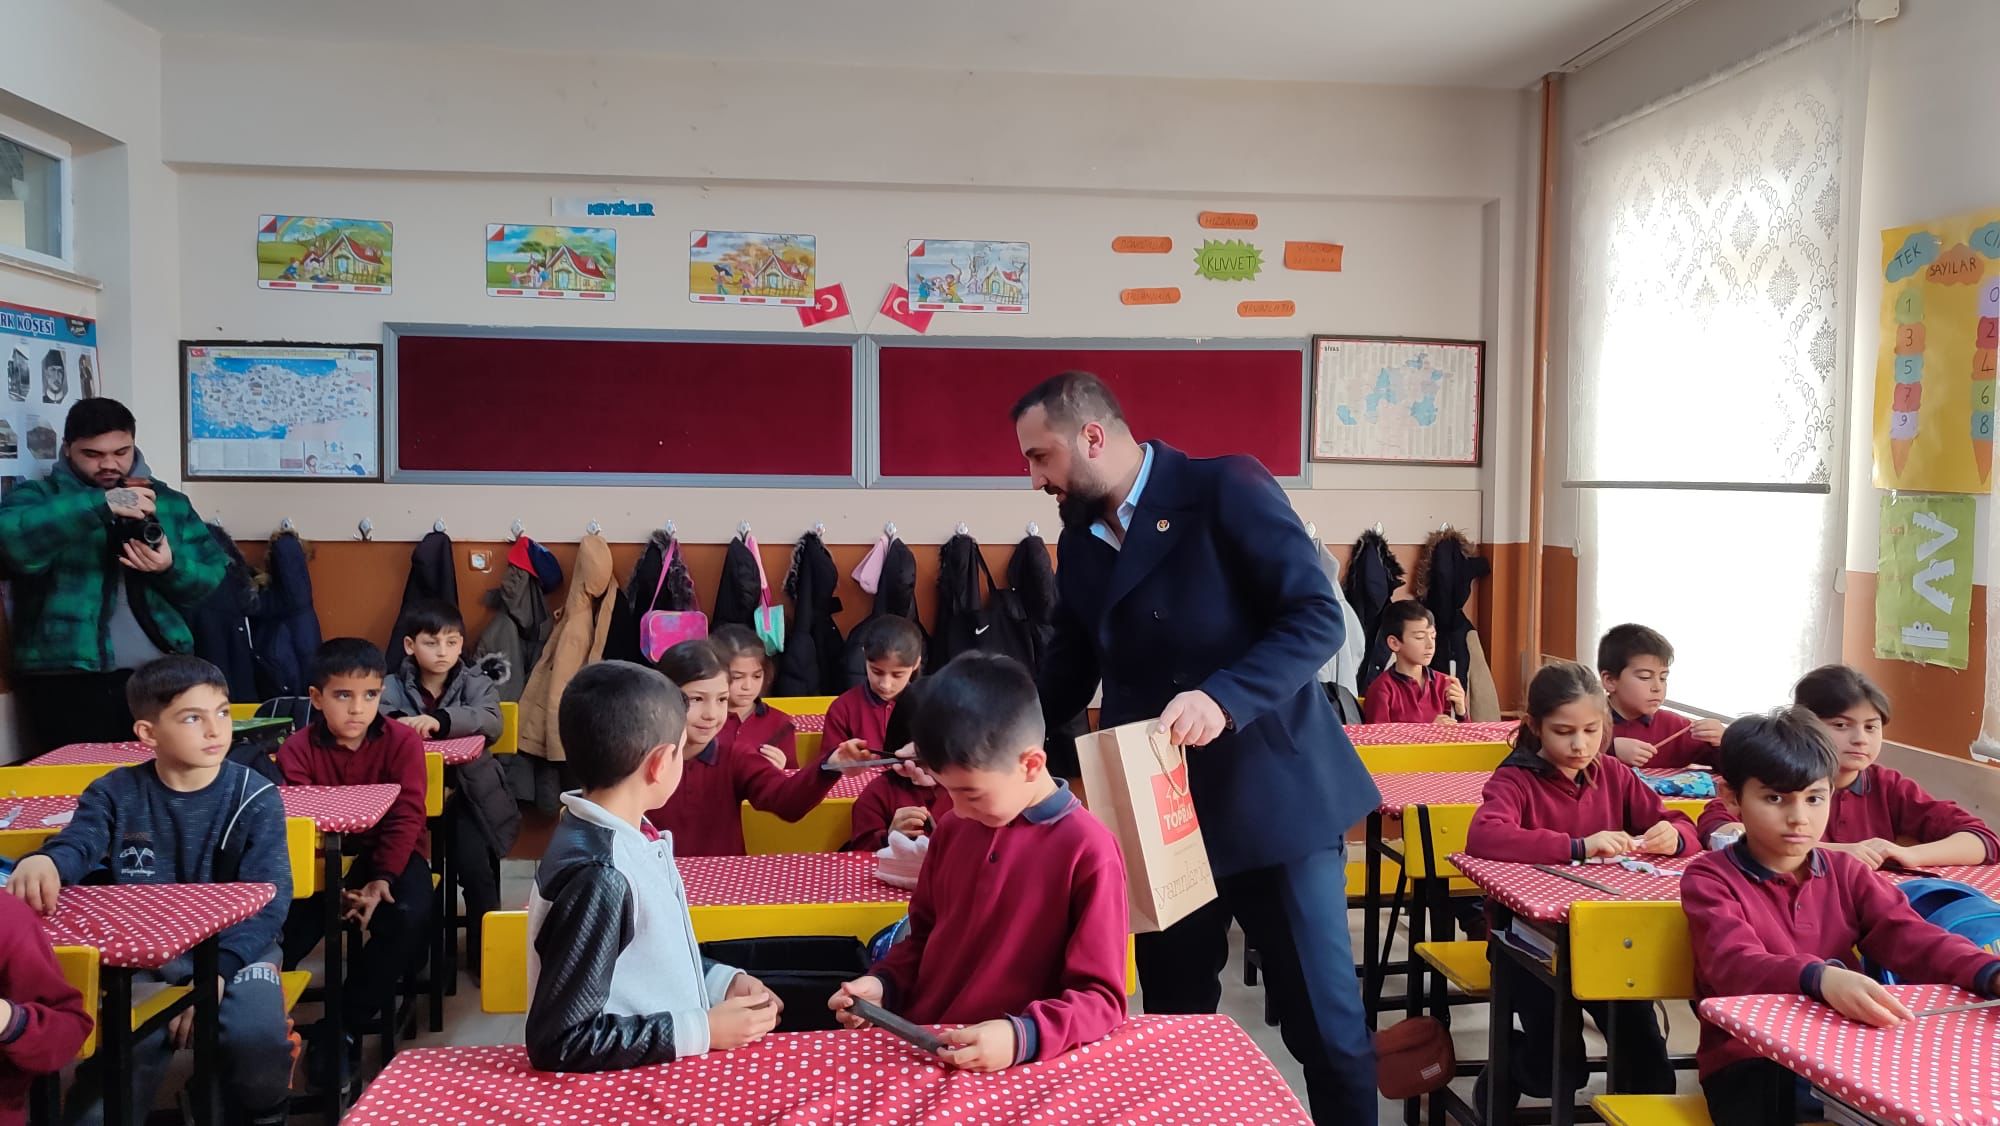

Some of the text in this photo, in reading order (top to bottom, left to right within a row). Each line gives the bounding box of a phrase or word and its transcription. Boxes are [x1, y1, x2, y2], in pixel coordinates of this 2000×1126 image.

[1207, 255, 1255, 272] KUVVET
[1894, 242, 1922, 268] TEK
[1929, 257, 1977, 276] SAYILAR
[1904, 298, 1912, 313] 1
[16, 313, 55, 336] KÖŞESİ
[1986, 321, 1995, 338] 2
[1904, 328, 1914, 347] 3
[1903, 360, 1913, 375] 5
[1903, 387, 1912, 402] 7
[1981, 384, 1990, 404] 6
[1899, 414, 1908, 427] 9
[1980, 415, 1989, 434] 8
